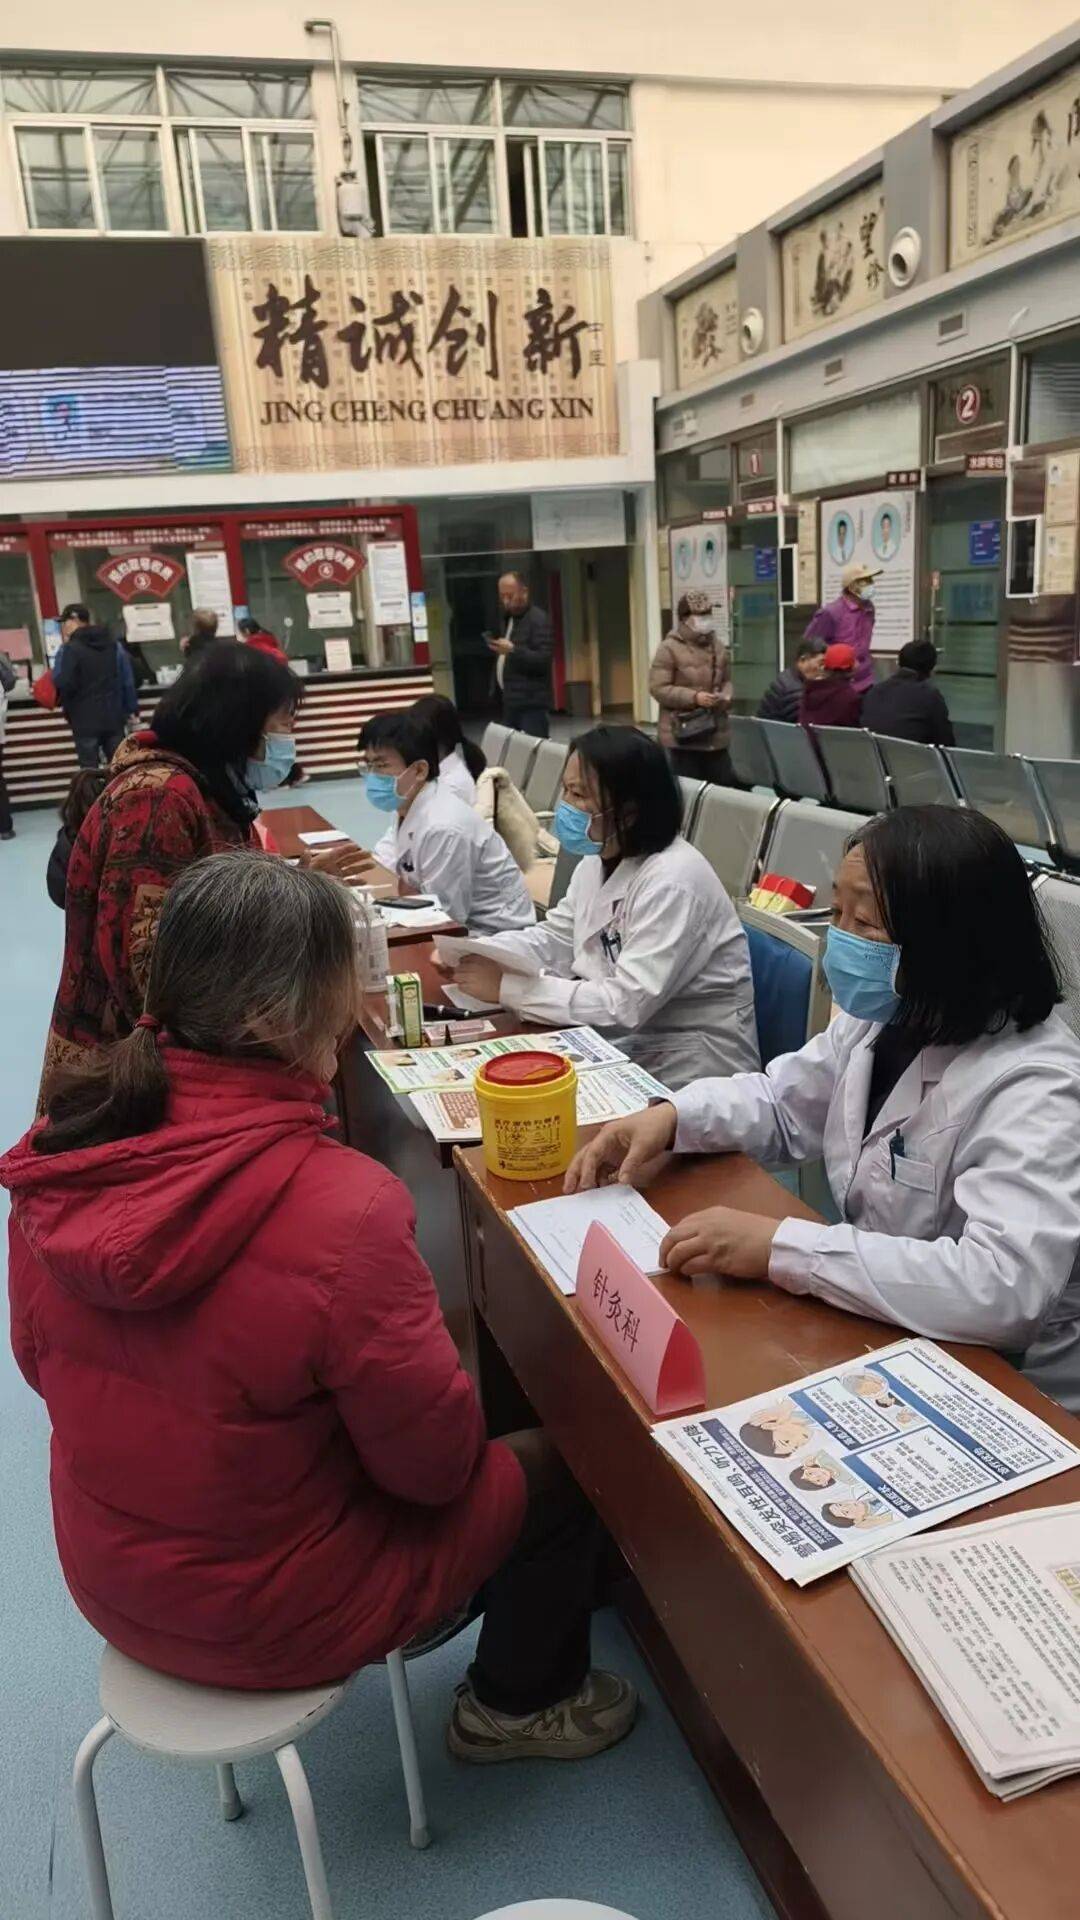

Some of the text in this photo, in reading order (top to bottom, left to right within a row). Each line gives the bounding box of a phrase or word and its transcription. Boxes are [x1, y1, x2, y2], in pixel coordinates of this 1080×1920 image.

[252, 274, 588, 390] 精诚创新
[260, 397, 594, 425] JING CHENG CHUANG XIN
[593, 1267, 641, 1353] 针灸科
[682, 1423, 818, 1558] 警惕突发性耳鸣、听力下降
